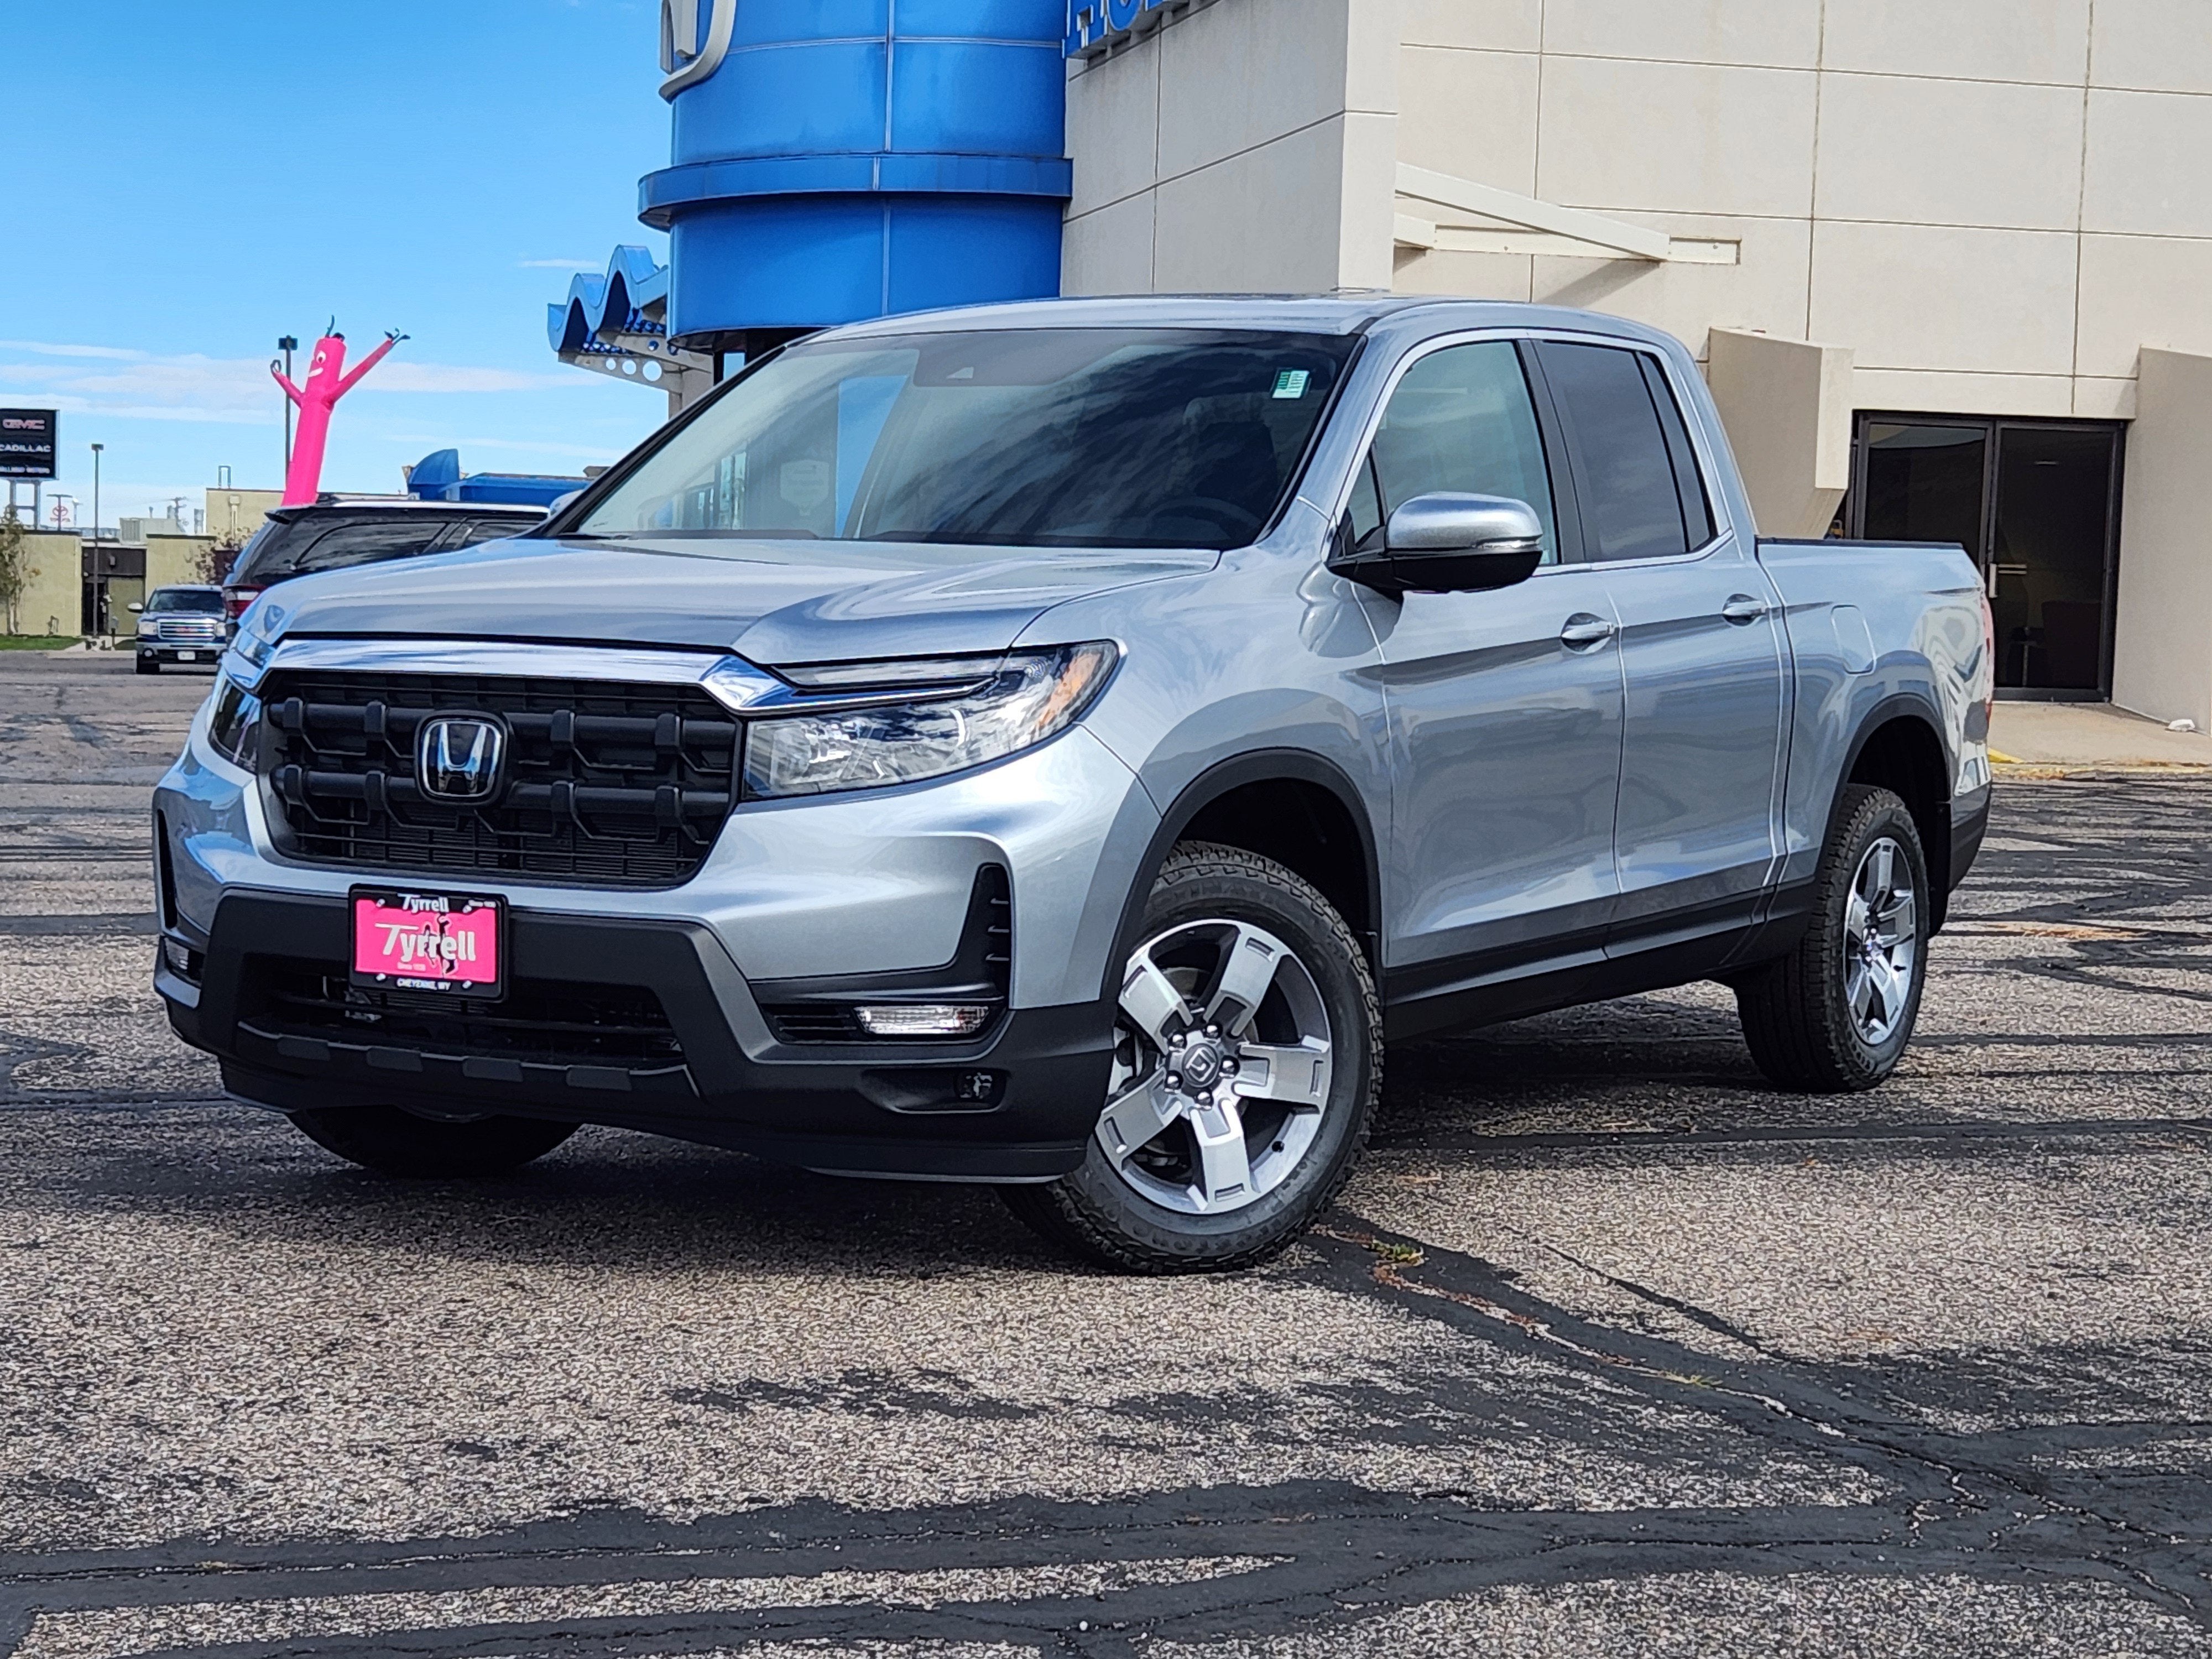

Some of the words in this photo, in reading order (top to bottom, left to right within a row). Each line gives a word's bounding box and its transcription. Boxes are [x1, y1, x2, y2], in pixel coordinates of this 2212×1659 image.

[2, 419, 45, 430] GMC
[0, 444, 51, 452] CADILLAC
[397, 893, 449, 914] Tyrrell
[374, 922, 476, 962] Tyrrell
